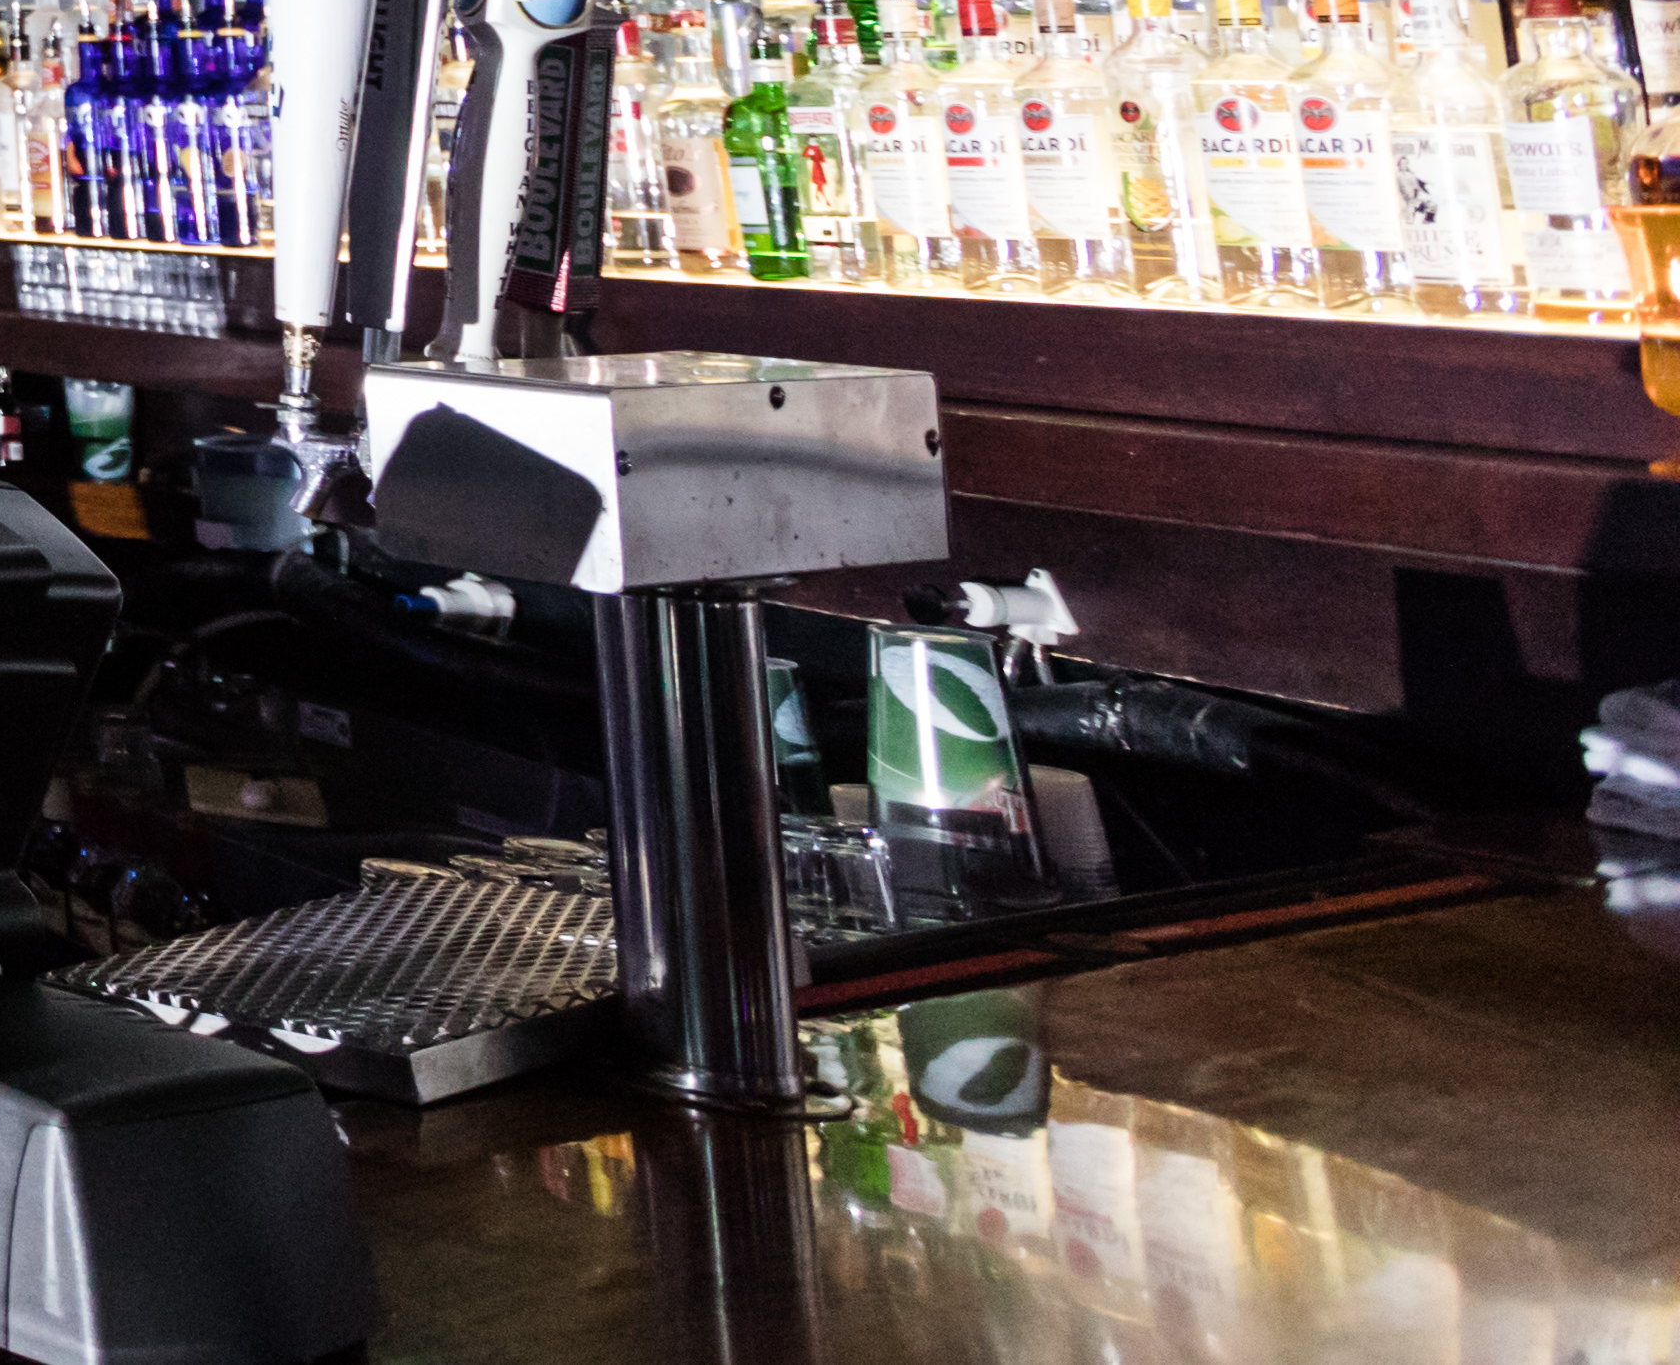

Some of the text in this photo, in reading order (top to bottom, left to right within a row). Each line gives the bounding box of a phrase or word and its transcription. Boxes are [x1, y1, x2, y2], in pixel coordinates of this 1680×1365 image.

[335, 97, 352, 153] Miller
[517, 57, 567, 262] BOULEVARD
[573, 62, 606, 266] BOULEVARD
